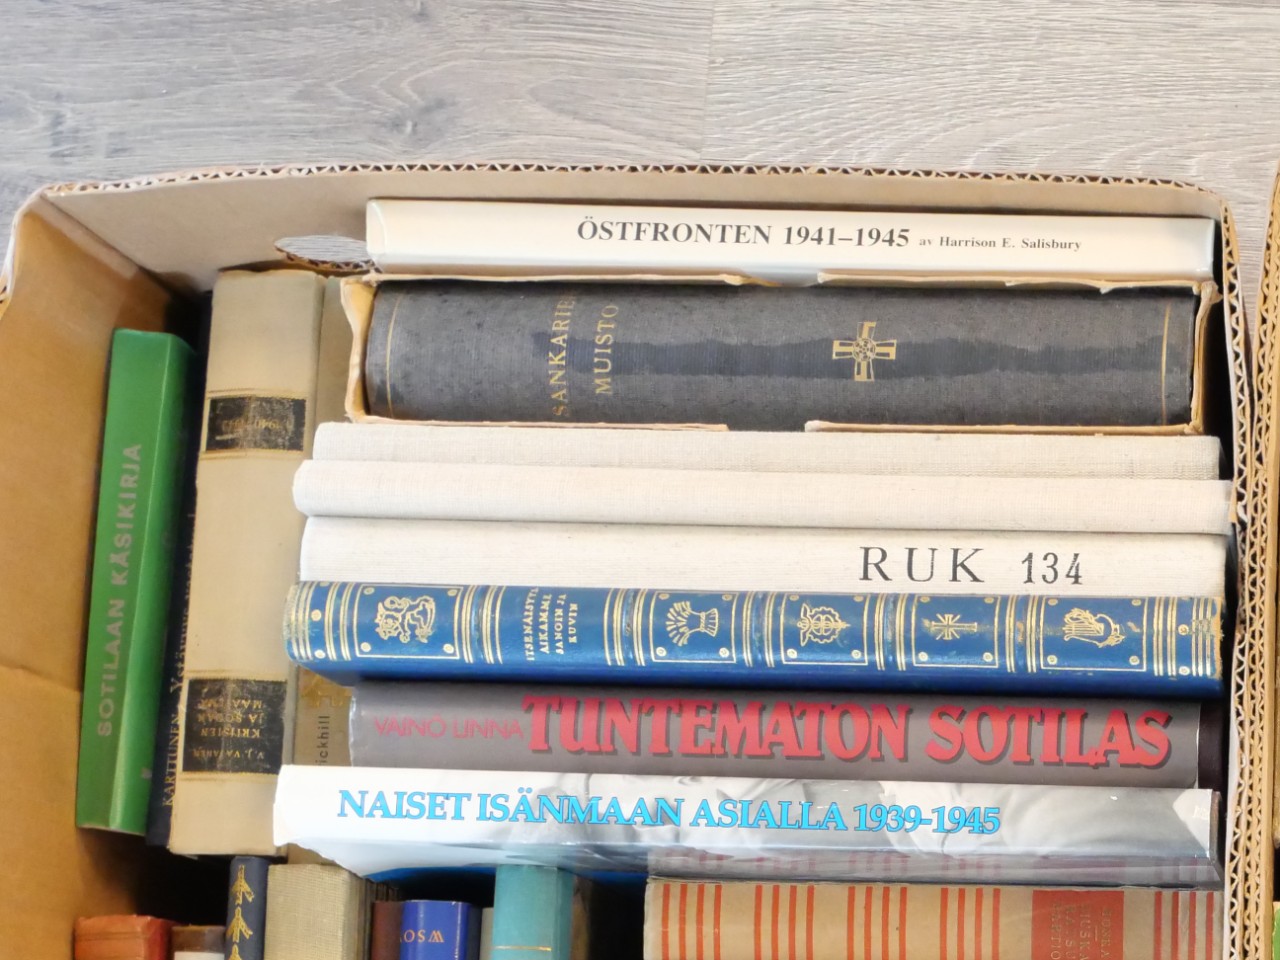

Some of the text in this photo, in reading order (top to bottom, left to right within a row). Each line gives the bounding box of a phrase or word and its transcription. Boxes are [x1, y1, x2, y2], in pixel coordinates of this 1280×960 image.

[577, 216, 772, 245] ÖSTFRONTEN
[919, 237, 933, 246] av
[939, 235, 997, 248] Harrison
[1002, 237, 1016, 249] E.
[1021, 237, 1082, 251] Salisbury
[594, 303, 619, 395] MUISTO
[859, 546, 1083, 585] RUK 134
[96, 443, 143, 738] SOTILAAN KÄSIKIRJA
[554, 593, 567, 655] SANOIN JA
[568, 602, 578, 643] KUVIN
[452, 715, 524, 742] LINNA
[521, 694, 1173, 769] TUNTEMATON SOTILAS
[338, 787, 1000, 835] NAISET ISÄNMAAN ASIALLA 1939-1945
